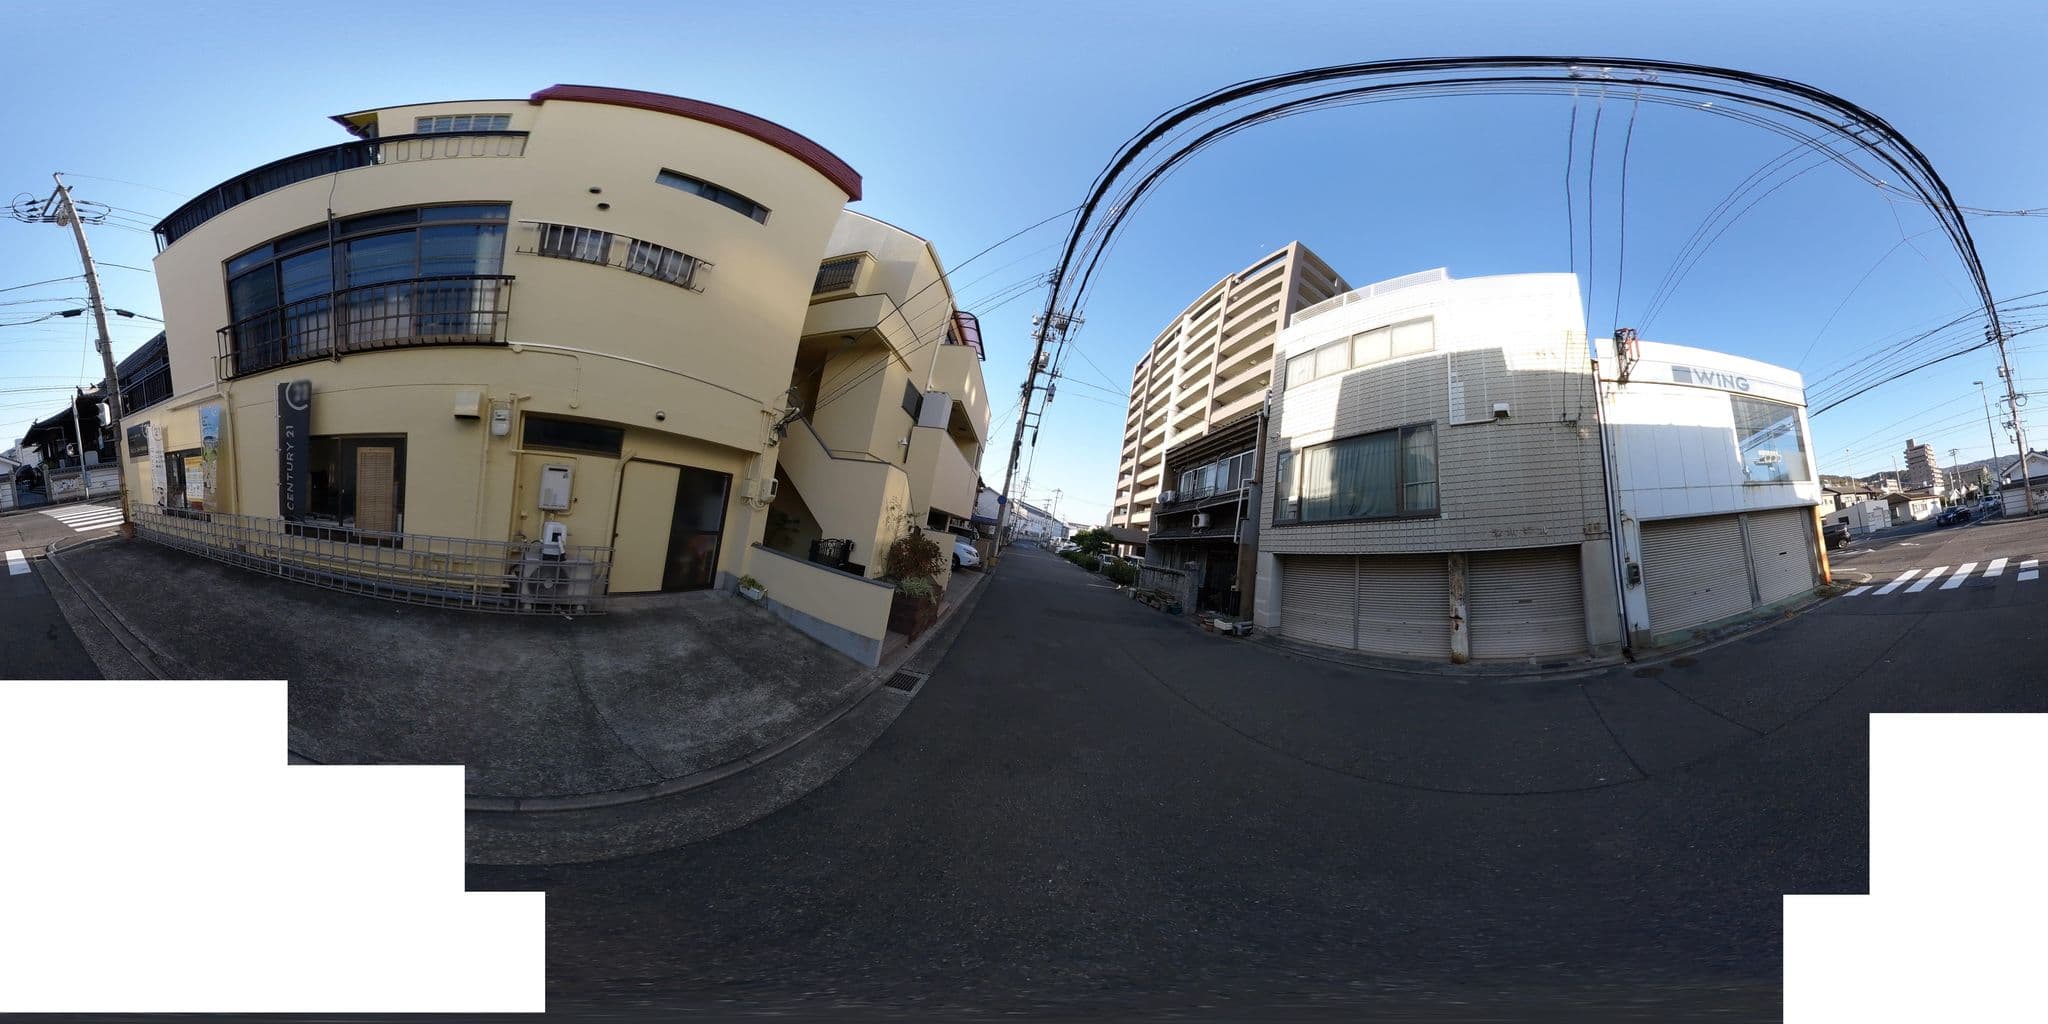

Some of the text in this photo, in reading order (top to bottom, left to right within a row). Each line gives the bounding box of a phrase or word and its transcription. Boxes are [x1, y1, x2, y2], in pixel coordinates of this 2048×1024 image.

[1693, 367, 1750, 392] WING
[286, 425, 294, 511] CENTURY 21
